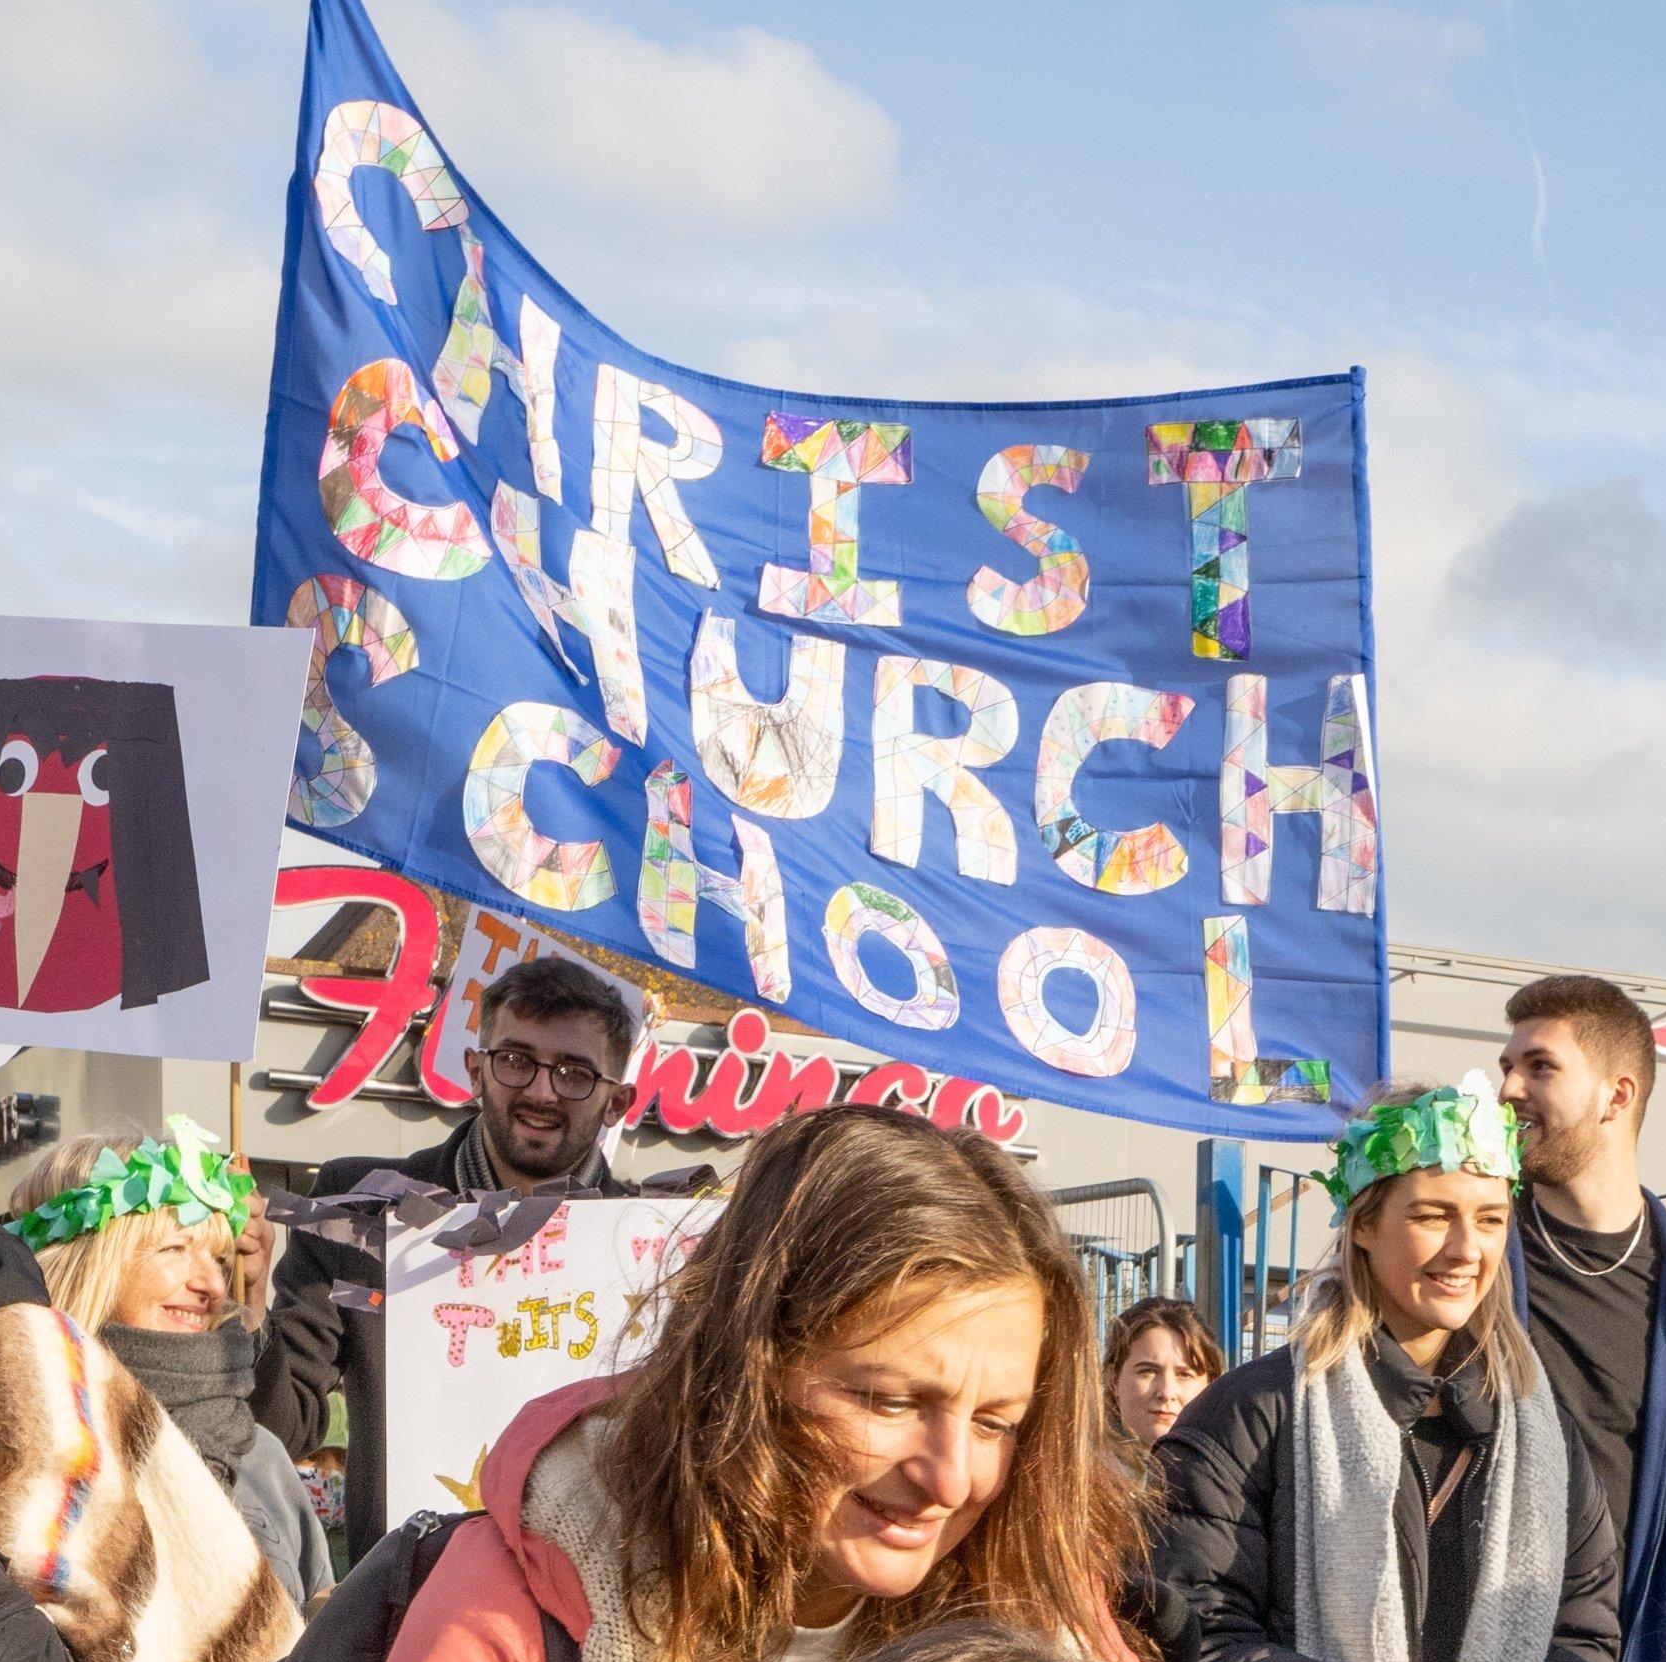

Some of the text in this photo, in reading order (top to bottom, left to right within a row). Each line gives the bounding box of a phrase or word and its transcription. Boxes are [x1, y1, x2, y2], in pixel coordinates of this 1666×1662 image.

[315, 98, 1302, 662] CHRIST
[319, 358, 1378, 917] CHURCH
[286, 575, 1331, 1103] SCHOOL
